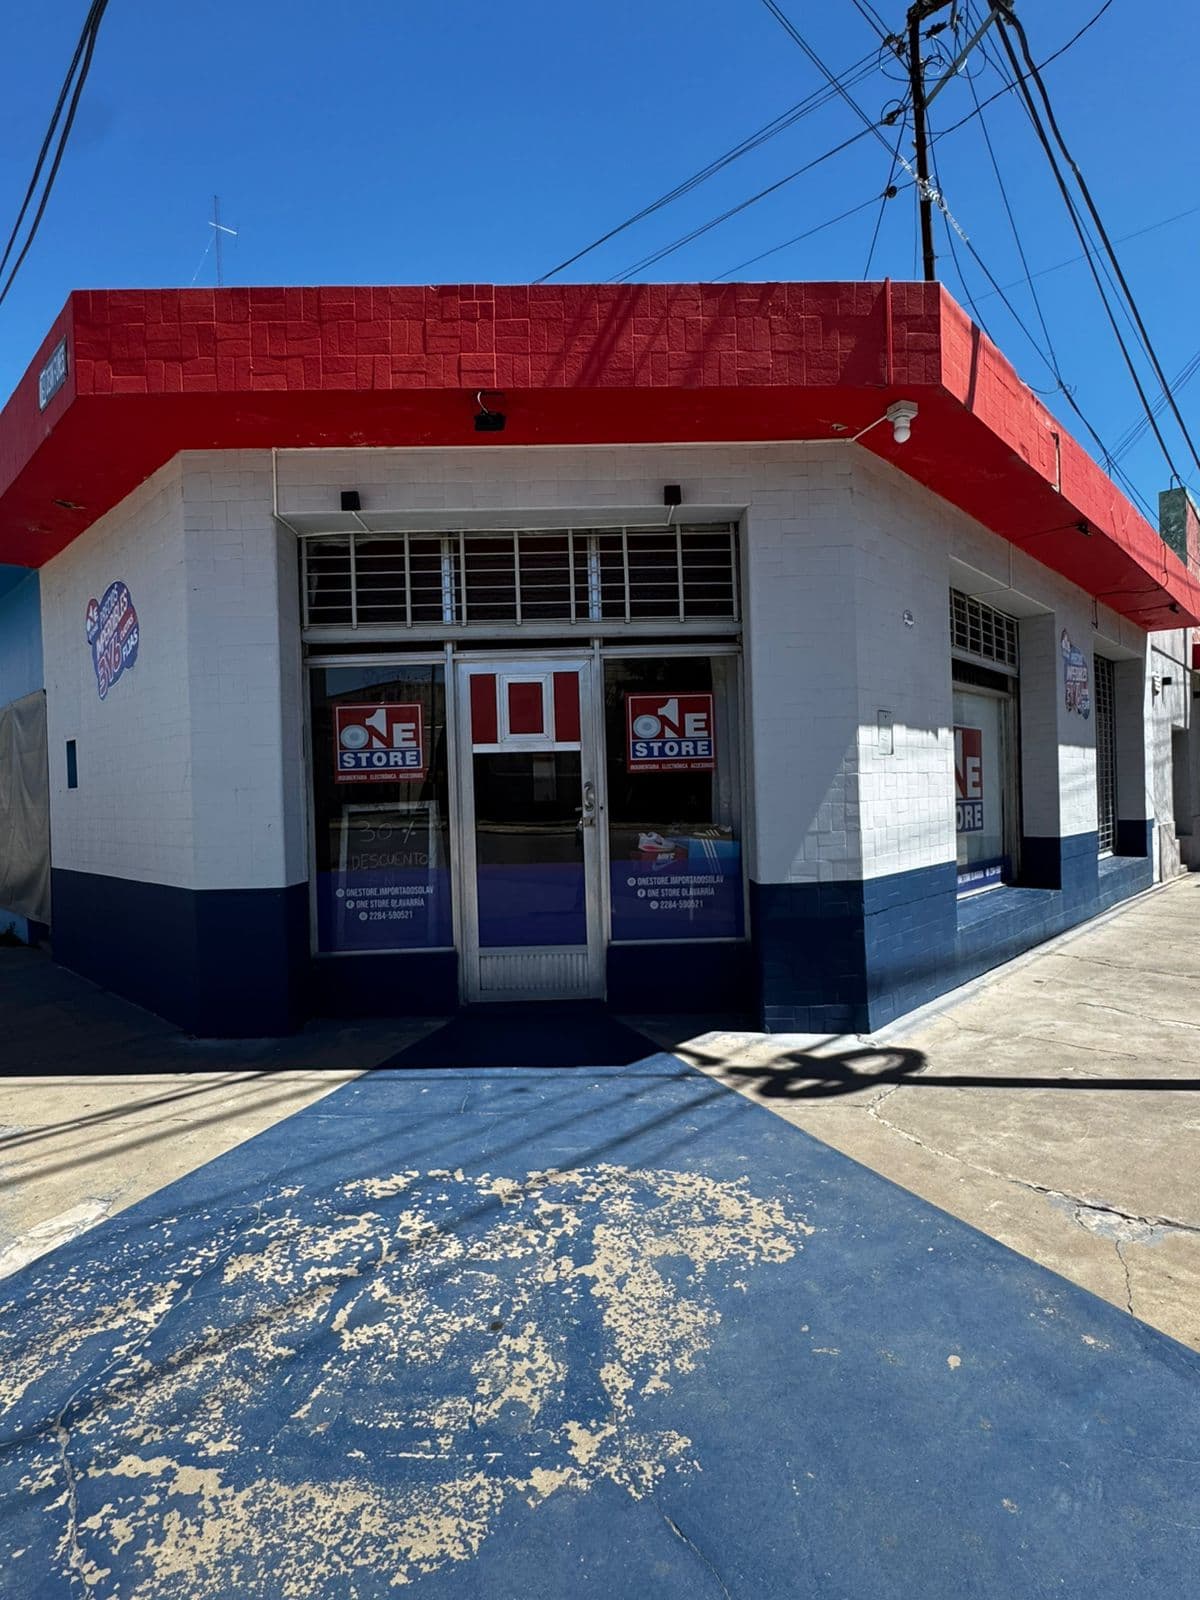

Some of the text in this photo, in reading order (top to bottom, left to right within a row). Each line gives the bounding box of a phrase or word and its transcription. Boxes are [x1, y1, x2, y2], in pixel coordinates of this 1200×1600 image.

[633, 698, 709, 739] ONE
[340, 708, 417, 749] ONE
[635, 741, 709, 757] STORE
[342, 751, 418, 767] STORE
[956, 729, 982, 799] NE
[956, 804, 982, 830] ORE
[351, 852, 428, 871] DESCUENTO
[647, 888, 659, 898] ONE
[661, 888, 681, 897] STORE
[356, 900, 369, 909] ONE
[370, 899, 390, 908] STORE
